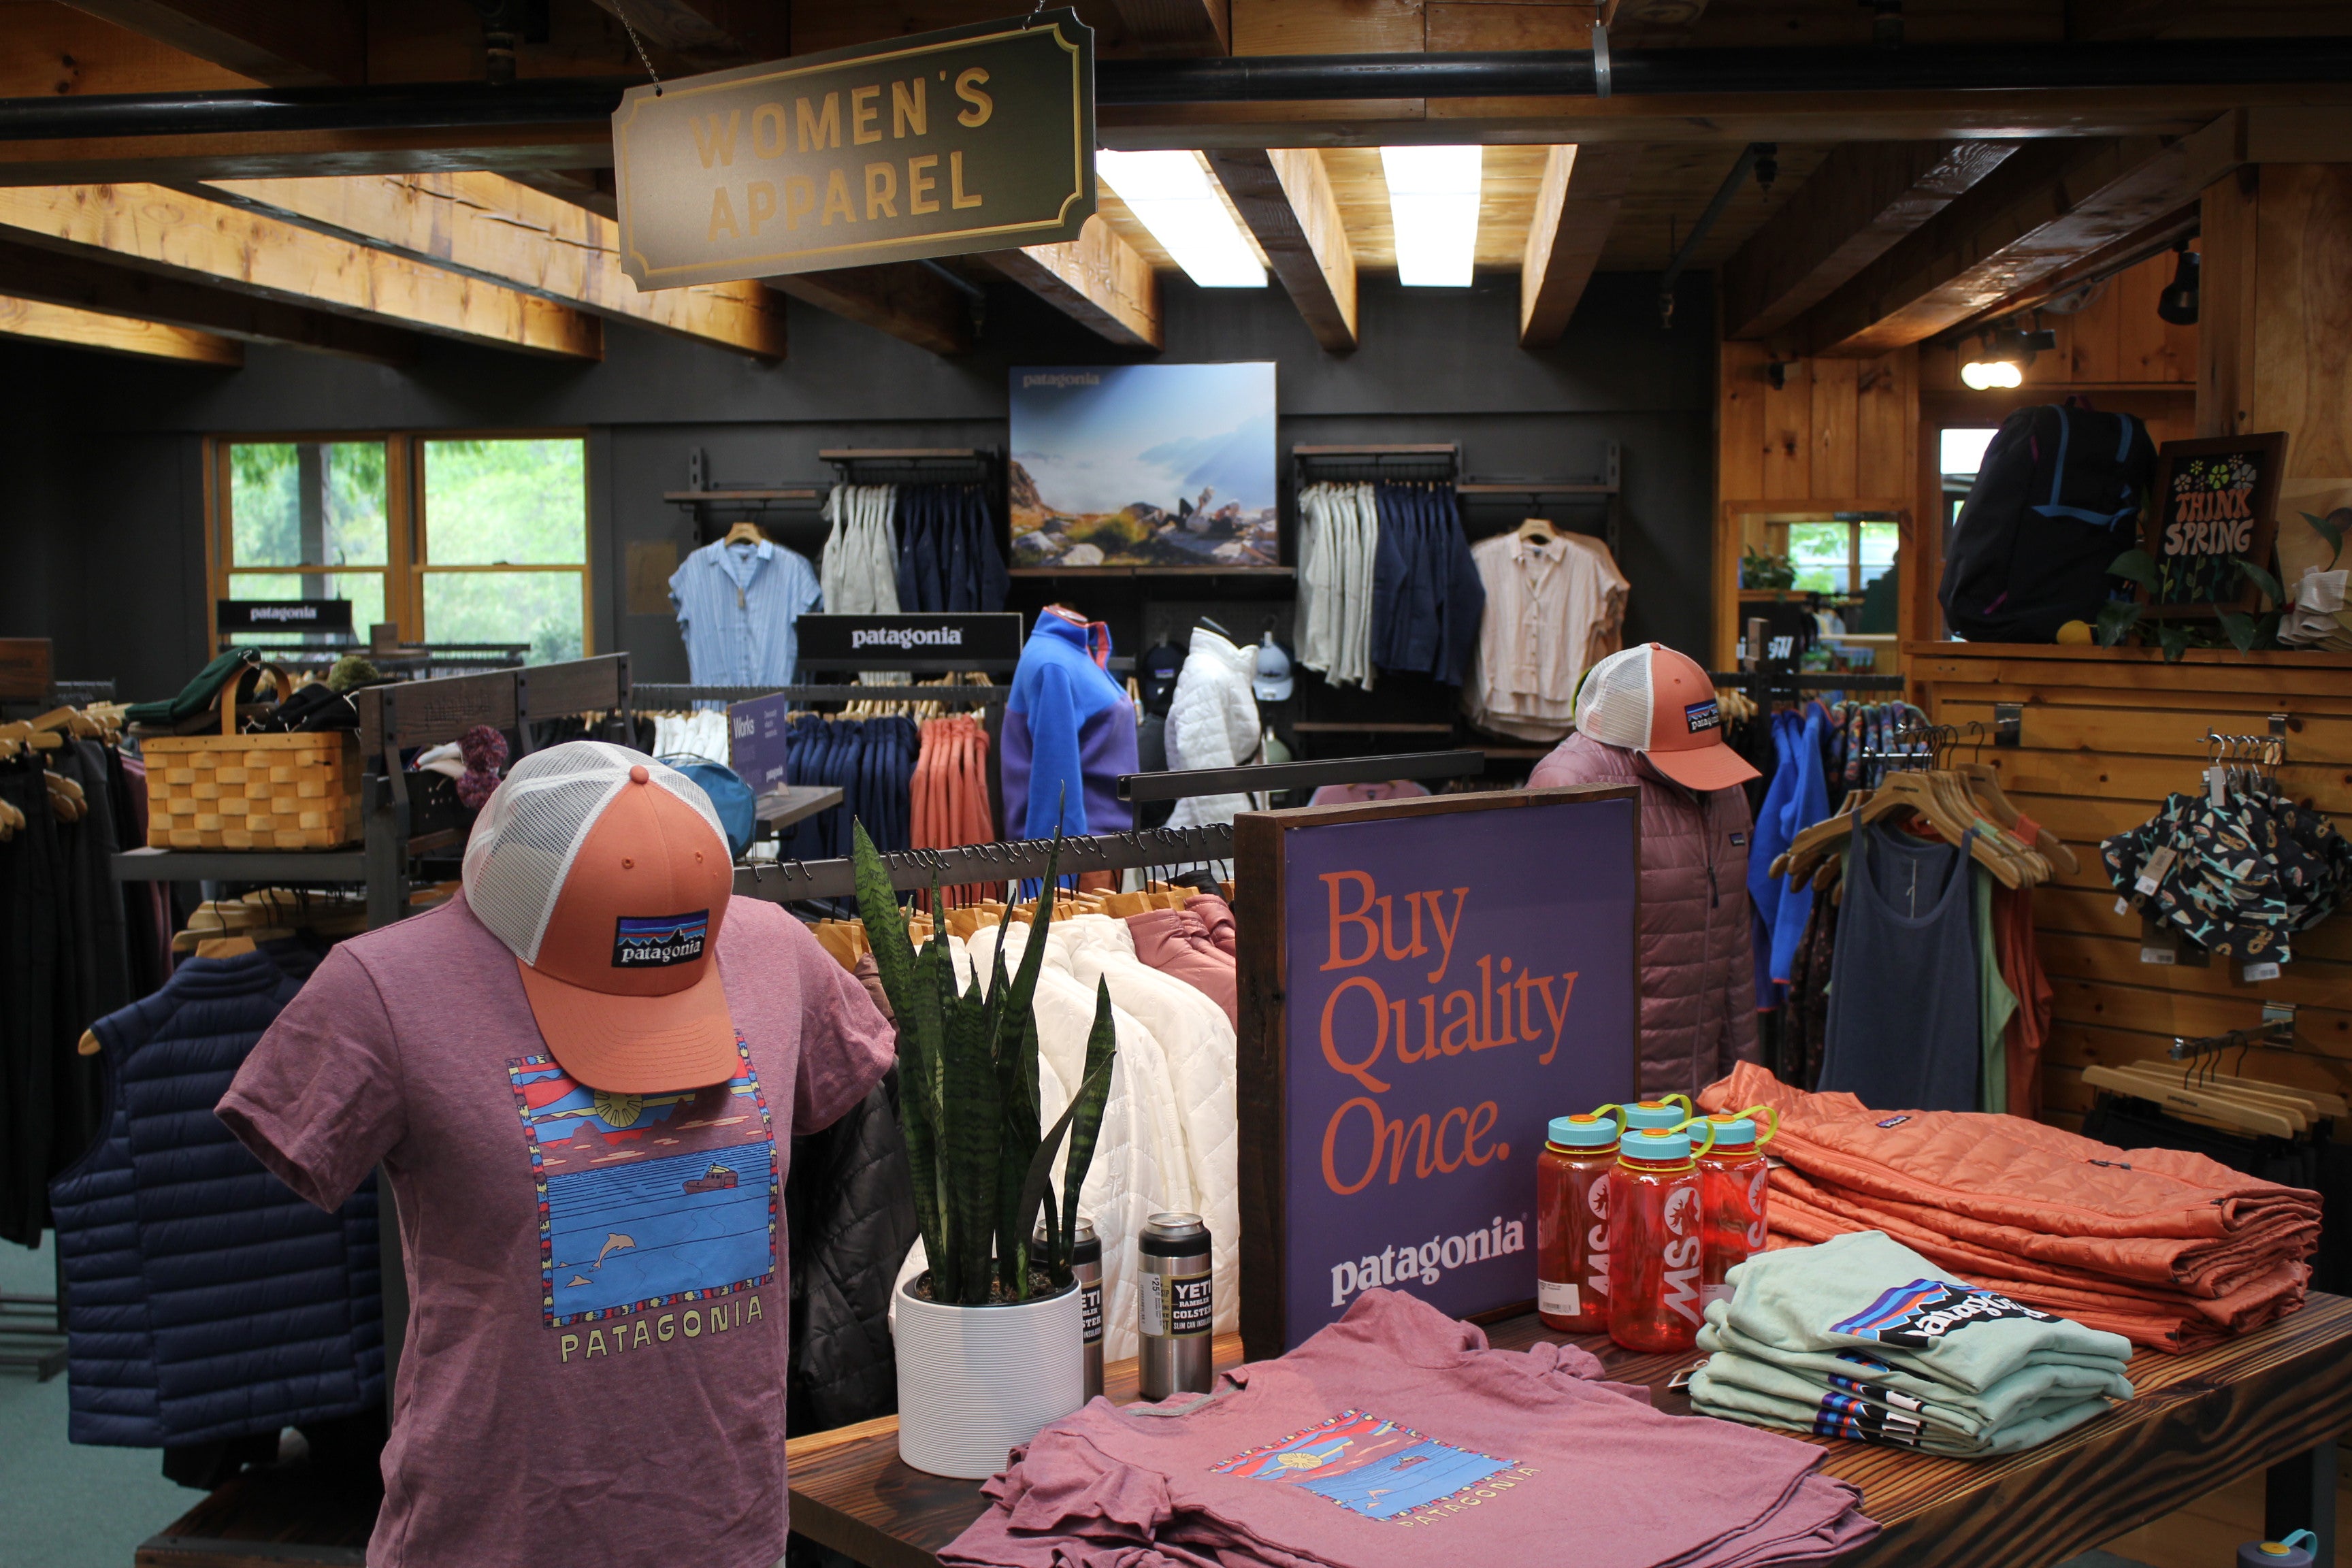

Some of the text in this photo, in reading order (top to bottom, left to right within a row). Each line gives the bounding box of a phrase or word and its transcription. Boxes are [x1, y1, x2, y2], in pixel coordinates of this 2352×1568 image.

[689, 67, 993, 169] WOMEN'S
[707, 151, 982, 242] APPAREL
[1023, 372, 1100, 389] patagonia
[2174, 487, 2251, 522] THINK
[2164, 519, 2254, 557] SPRING
[250, 606, 317, 622] patagonia
[852, 626, 962, 649] patagonia
[733, 715, 755, 739] Works
[1318, 870, 1470, 984] Buy
[621, 939, 701, 963] patagonia
[1319, 954, 1579, 1093] Quality
[1321, 1096, 1509, 1196] Once.
[1330, 1215, 1525, 1307] patagonia
[1082, 1290, 1100, 1308] ETI
[1175, 1279, 1211, 1299] YETI
[1082, 1316, 1100, 1328] STER
[1083, 1307, 1098, 1317] BLER
[1173, 1322, 1186, 1330] SLIM
[1186, 1320, 1196, 1328] CAN
[560, 1294, 764, 1362] PATAGONIA
[1397, 1467, 1542, 1528] PATAGONIA
